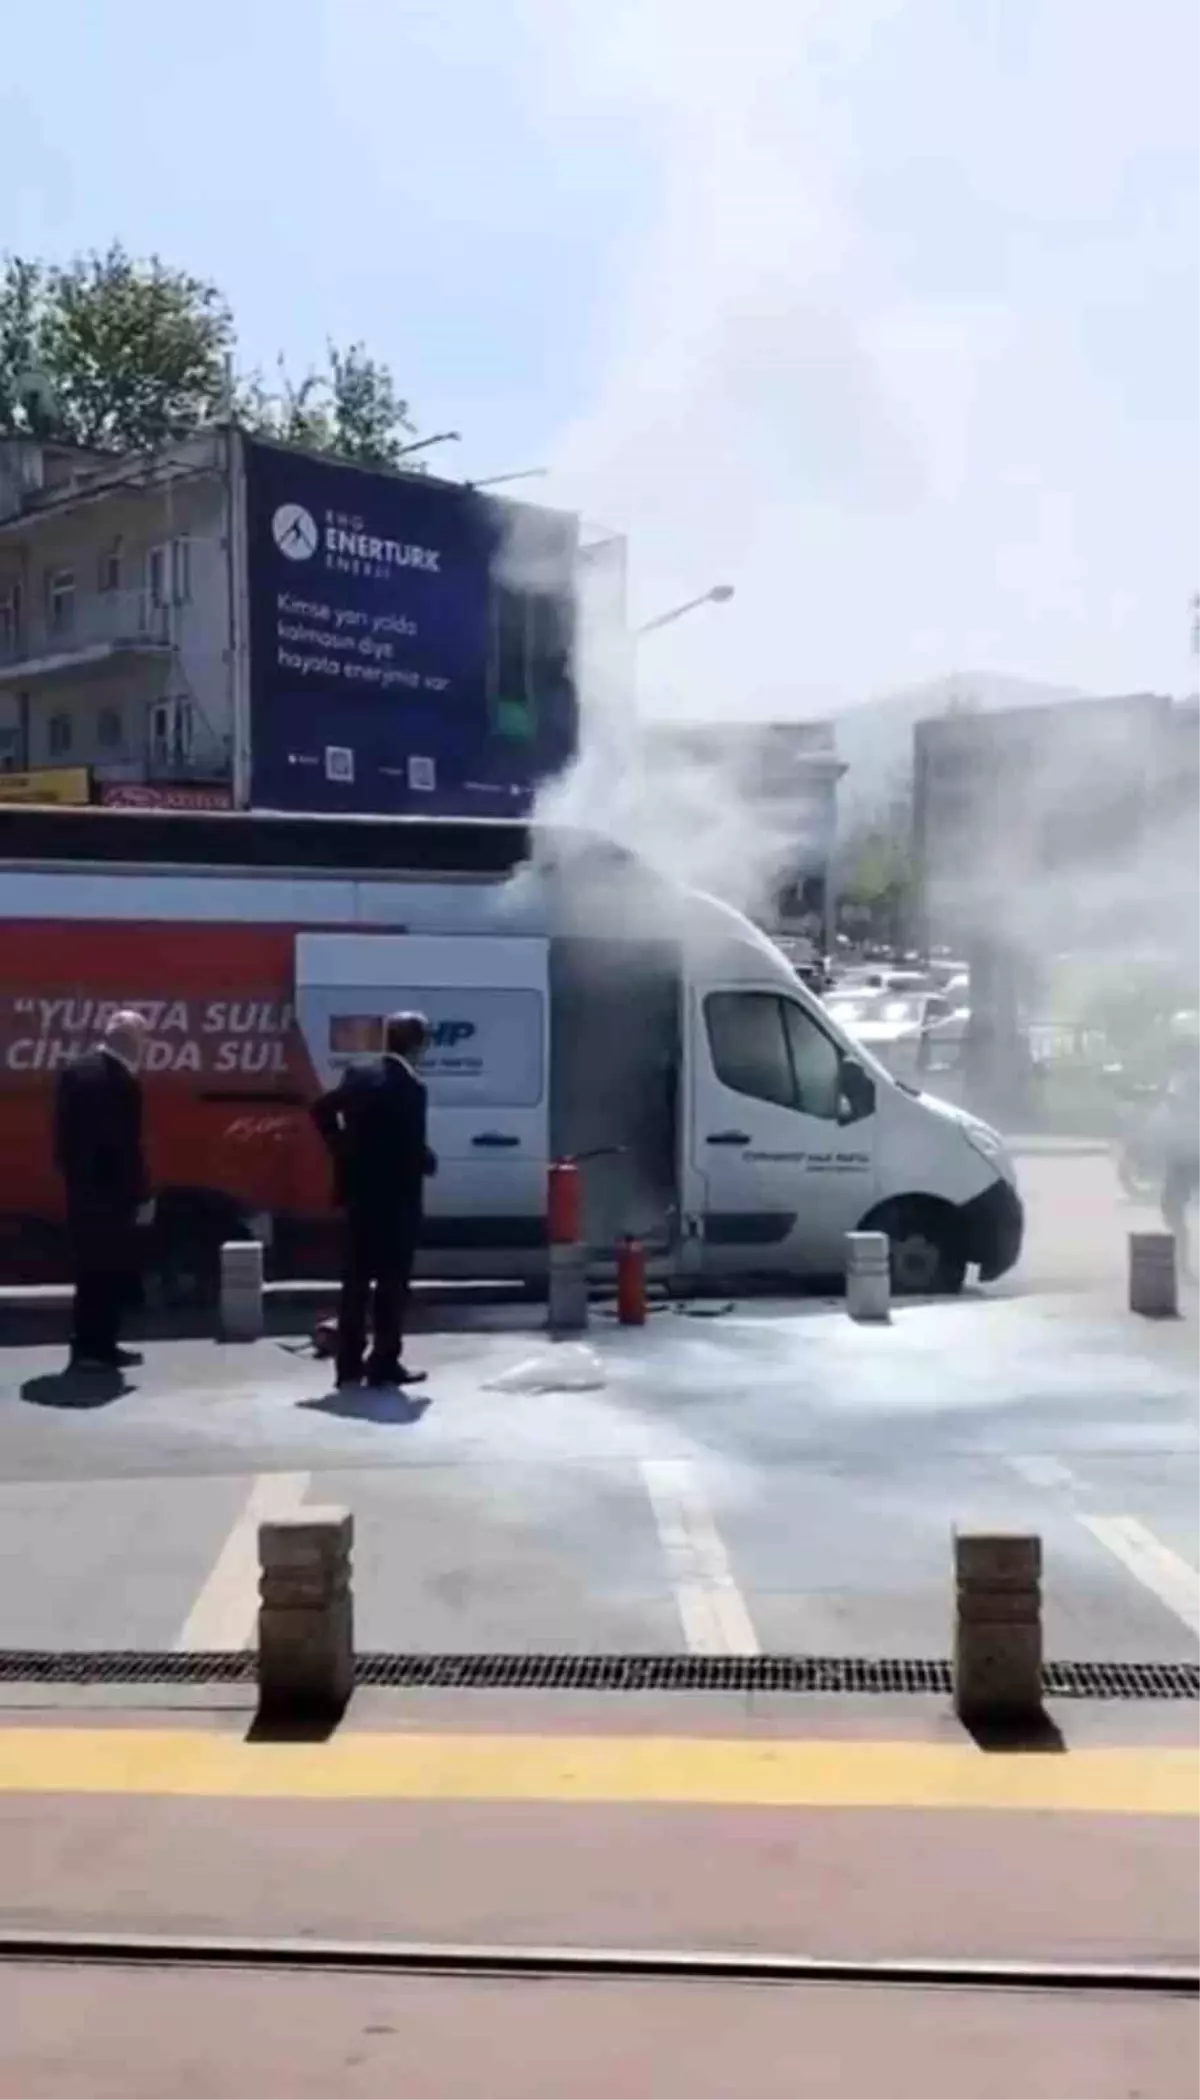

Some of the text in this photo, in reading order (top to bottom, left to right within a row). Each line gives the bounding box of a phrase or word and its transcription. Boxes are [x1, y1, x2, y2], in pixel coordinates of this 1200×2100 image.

[277, 593, 331, 621] Kimse
[277, 646, 341, 676] hayata
[427, 1020, 476, 1048] HP
[7, 1039, 203, 1073] CIHDA
